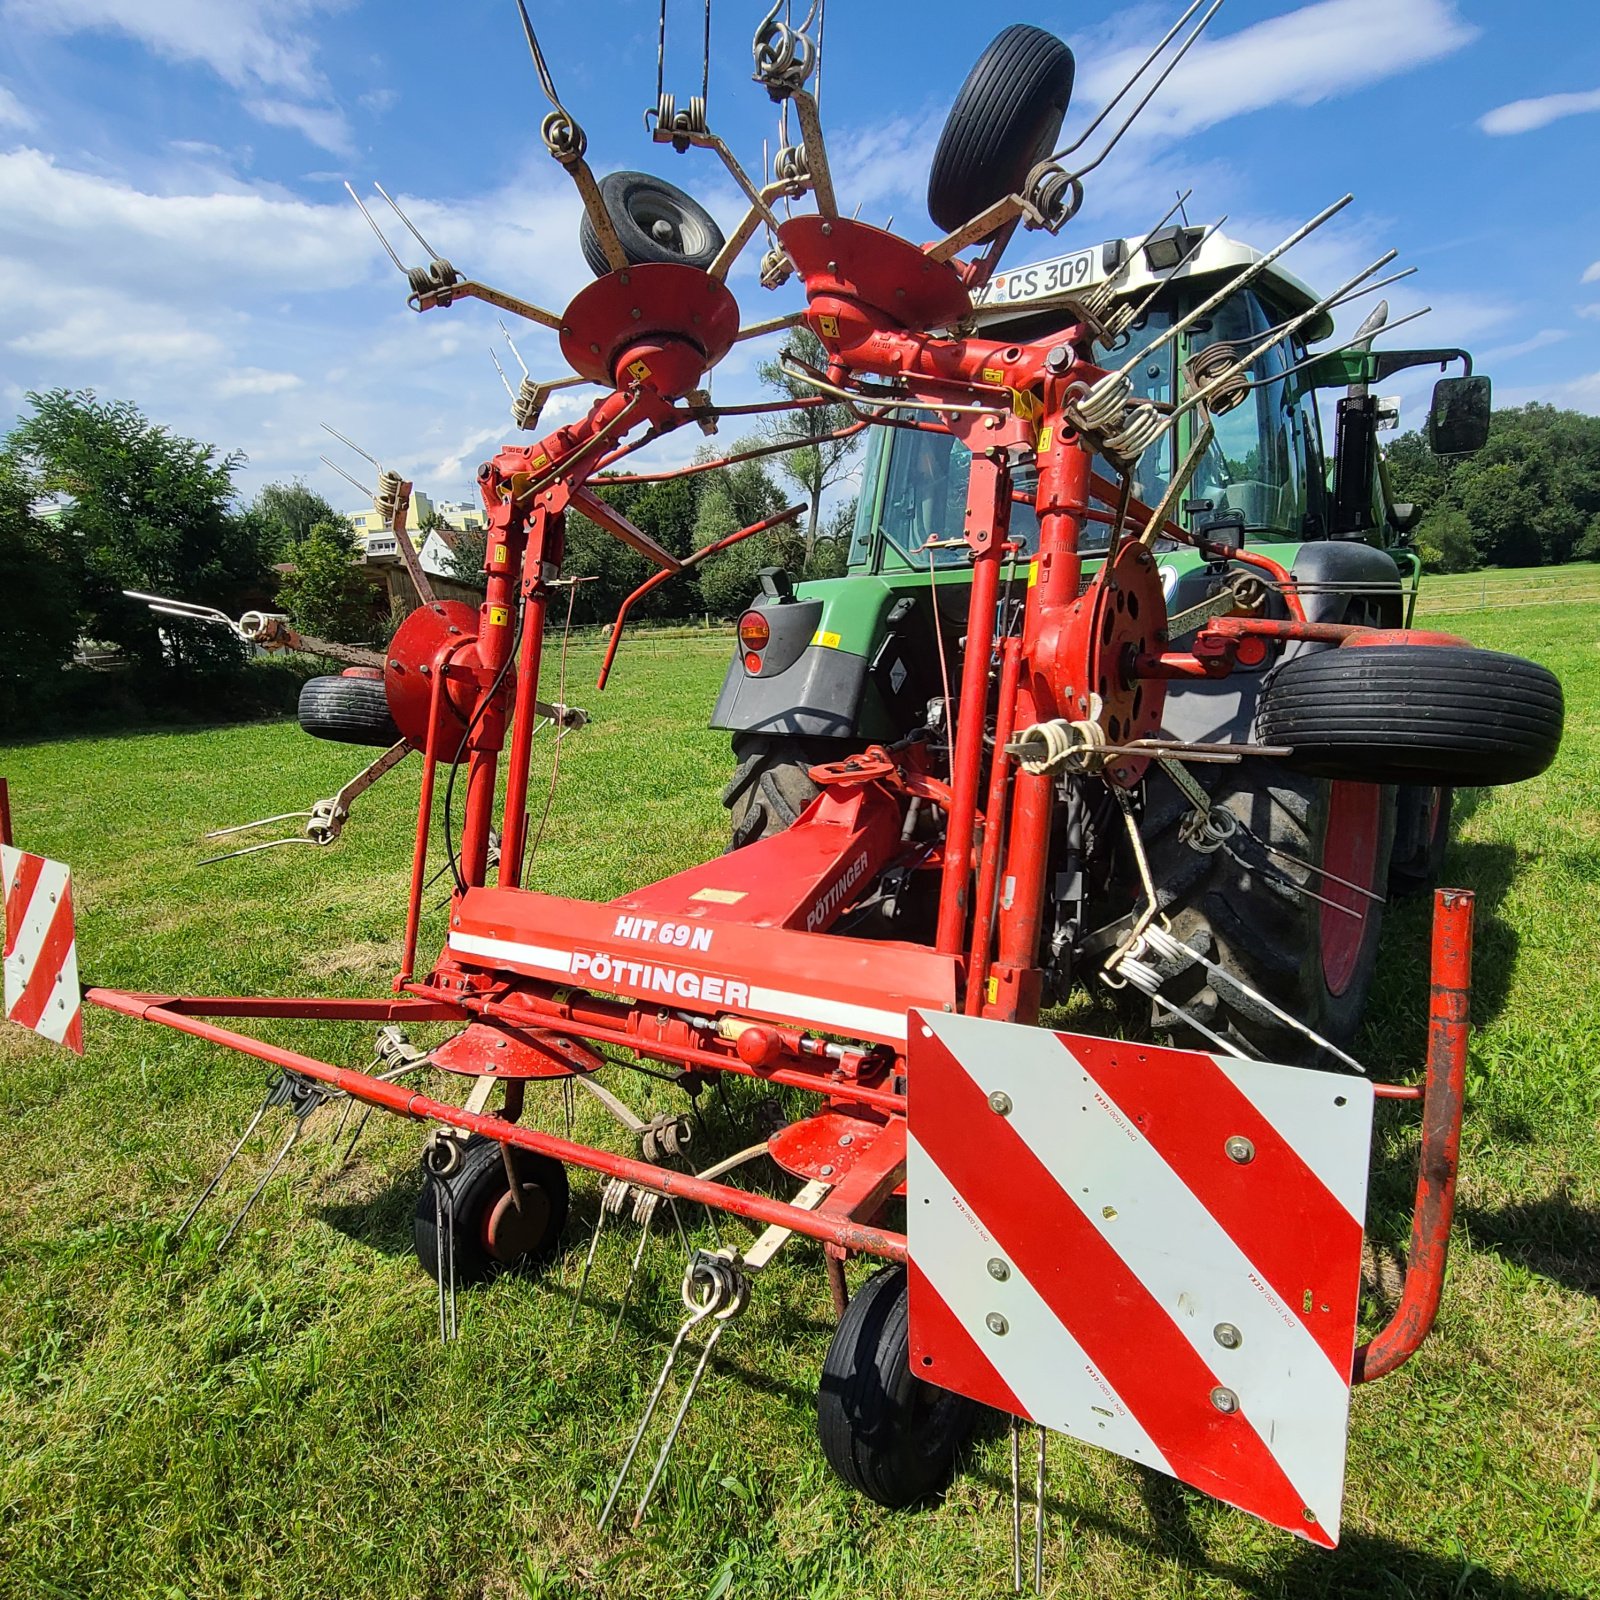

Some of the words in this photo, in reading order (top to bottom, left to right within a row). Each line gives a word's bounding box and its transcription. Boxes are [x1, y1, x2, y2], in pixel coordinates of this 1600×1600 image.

[1008, 270, 1038, 300] CS
[1044, 256, 1089, 292] 309
[806, 850, 868, 933] PÖTTINGER
[614, 915, 658, 942] HIT
[570, 951, 749, 1009] PÖTTINGER
[1125, 1129, 1138, 1142] DIN
[979, 1230, 990, 1242] DIN
[1282, 1314, 1296, 1328] DIN
[1114, 1403, 1126, 1416] DIN
